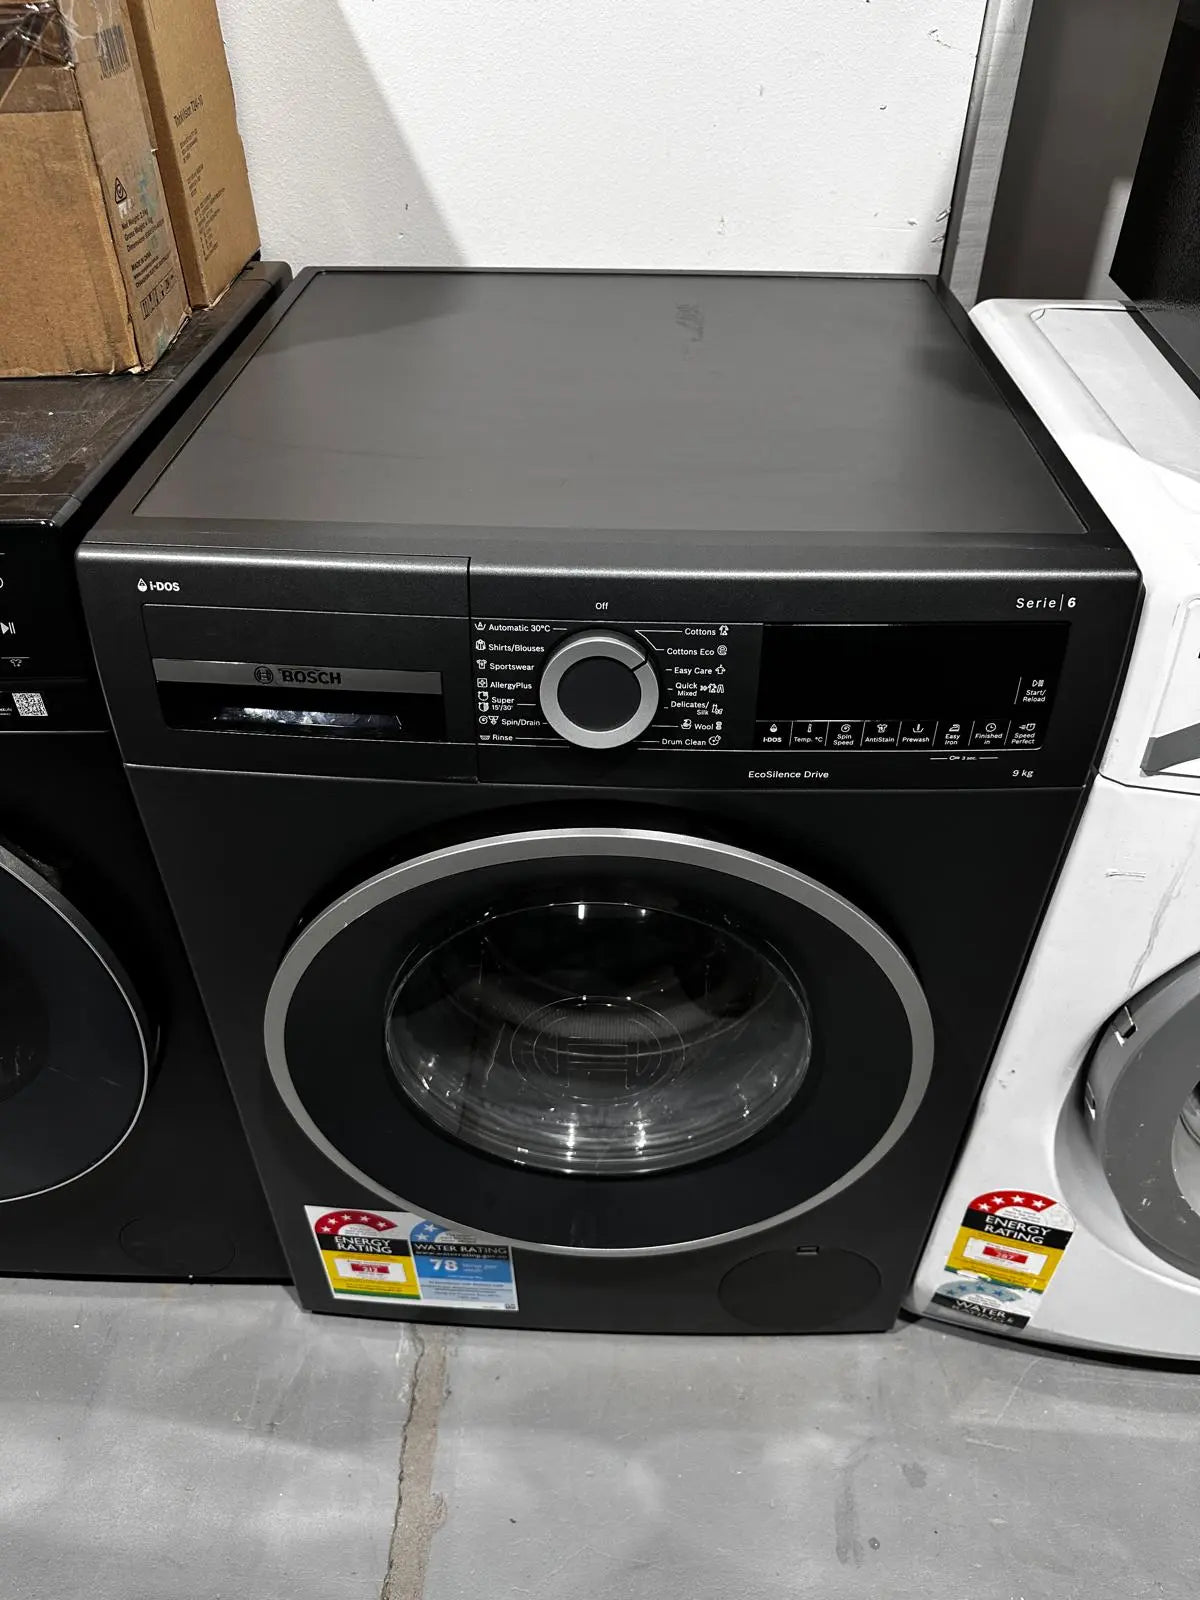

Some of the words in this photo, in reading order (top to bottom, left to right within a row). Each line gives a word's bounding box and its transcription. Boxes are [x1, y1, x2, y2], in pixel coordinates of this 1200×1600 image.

[149, 581, 181, 592] i-DOS
[595, 602, 609, 610] Off
[1015, 598, 1057, 609] Serie
[1067, 597, 1077, 608] 6
[488, 624, 529, 632] Automatic
[684, 628, 717, 636] Cottons
[488, 644, 545, 653] Shirts/Blouses
[666, 648, 698, 656] Cottons
[699, 648, 715, 656] Eco
[489, 663, 535, 671] Sportswear
[674, 667, 693, 676] Easy
[693, 667, 713, 675] Care
[282, 669, 342, 685] BOSCH
[489, 682, 533, 691] AllergyPlus
[675, 682, 698, 690] Quick
[491, 697, 515, 705] Super
[670, 701, 710, 710] Delicates/
[501, 719, 541, 727] Spin/Drain
[492, 733, 514, 741] Rinse
[945, 733, 961, 741] Easy
[661, 739, 682, 747] Drum
[683, 739, 707, 747] Clean
[748, 771, 802, 779] EcoSilence
[803, 771, 829, 779] Drive
[1012, 769, 1020, 777] 9
[1021, 770, 1034, 778] kg
[985, 1215, 1052, 1236] ENERGY
[984, 1225, 1045, 1245] RATING
[335, 1236, 391, 1247] ENERGY
[337, 1243, 392, 1254] RATING
[415, 1243, 457, 1252] WATER
[460, 1246, 507, 1254] RATING
[430, 1258, 458, 1272] 78
[955, 1299, 1007, 1318] WATER
